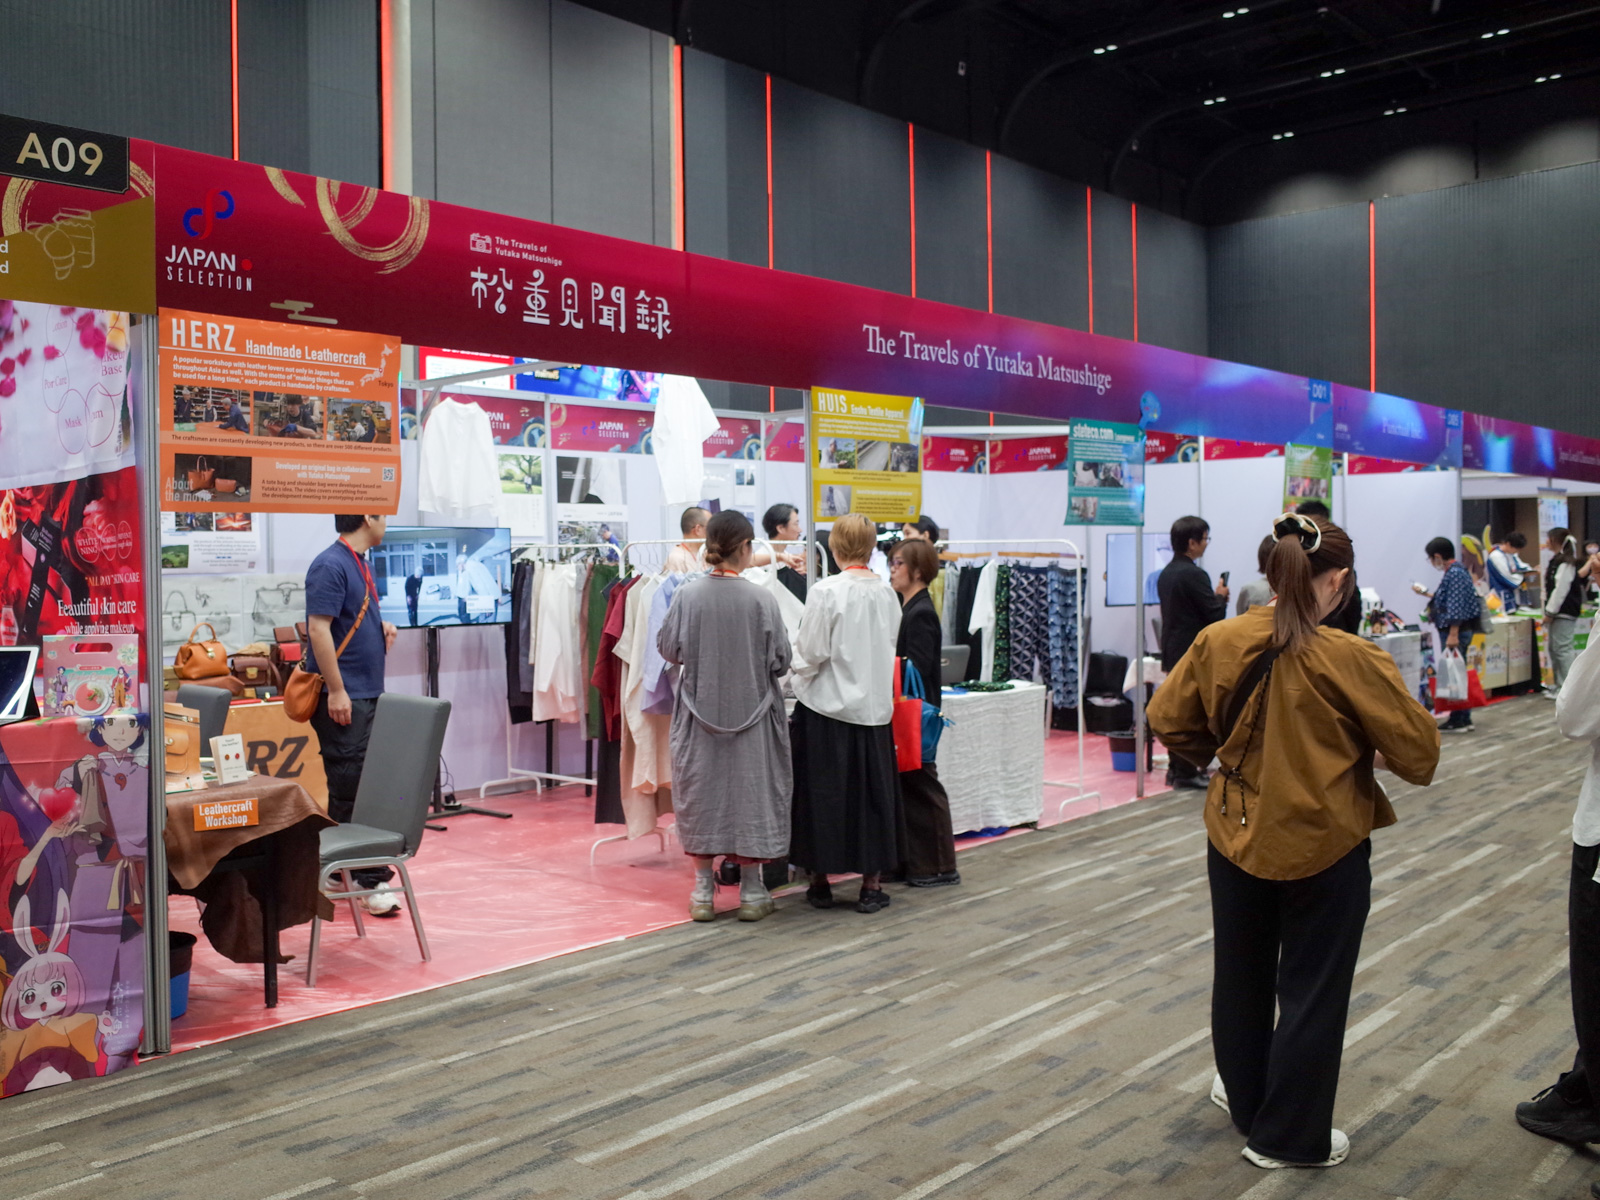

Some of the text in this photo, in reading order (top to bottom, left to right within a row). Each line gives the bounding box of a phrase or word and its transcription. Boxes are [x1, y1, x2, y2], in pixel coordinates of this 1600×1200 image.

[16, 132, 104, 176] A09
[494, 236, 548, 253] The Travels of
[165, 244, 236, 273] JAPAN
[495, 247, 562, 266] Yutaka Matsushige
[167, 266, 252, 292] SELECTION
[470, 266, 672, 340] 松重見聞録
[172, 318, 366, 366] HERZ Handmade Leathercraft
[863, 324, 1112, 395] The Travels of Yutaka Matsushige
[179, 356, 202, 366] popular
[203, 358, 232, 369] workshop
[247, 362, 267, 370] leather
[268, 364, 284, 372] lovers
[296, 367, 307, 376] only
[314, 368, 330, 378] Japan
[172, 363, 208, 374] throughout
[208, 366, 221, 374] Asia
[230, 368, 243, 376] well.
[269, 372, 286, 380] motto
[316, 377, 333, 386] things
[212, 374, 225, 384] long
[244, 377, 258, 385] each
[259, 378, 280, 388] product
[287, 381, 315, 390] handmade
[316, 383, 322, 392] by
[378, 380, 394, 388] Tokyo
[818, 392, 848, 413] HUIS
[64, 416, 82, 429] Mask
[487, 412, 504, 422] PAN
[492, 422, 510, 430] CTION
[598, 422, 624, 430] JAPAN
[598, 430, 630, 438] SELECTION
[713, 430, 729, 438] APAN
[218, 437, 244, 445] constantly
[245, 439, 272, 447] developing
[166, 476, 194, 490] About
[165, 490, 180, 502] the
[78, 538, 98, 547] WHITE
[80, 546, 98, 555] NING
[124, 572, 140, 584] CARE
[118, 600, 136, 614] care
[65, 620, 134, 634] while applying makeup
[246, 736, 308, 778] RZ
[199, 800, 253, 816] Leathercraft
[205, 813, 248, 828] Workshop
